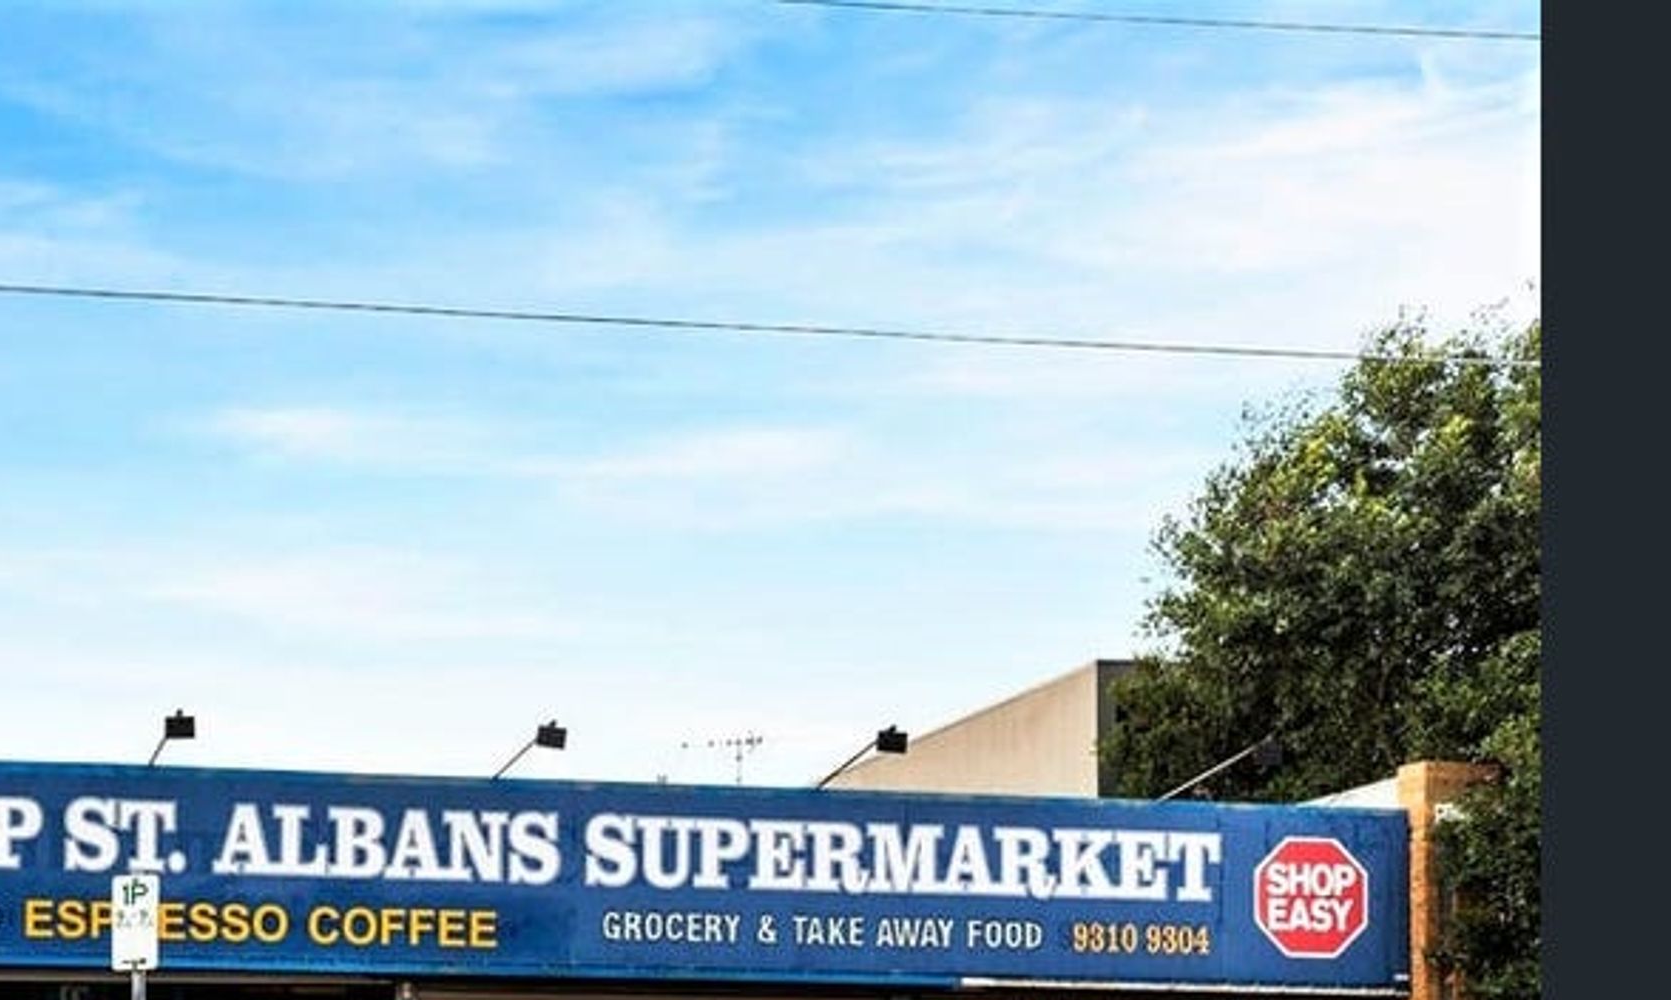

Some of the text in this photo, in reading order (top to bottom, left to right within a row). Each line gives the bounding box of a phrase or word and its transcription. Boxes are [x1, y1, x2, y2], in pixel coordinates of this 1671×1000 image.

[62, 796, 187, 874] ST.
[212, 803, 560, 887] ALBANS
[584, 813, 1223, 904] SUPERMARKET
[1266, 862, 1356, 896] SHOP
[24, 900, 289, 942] ESPESSO
[307, 905, 499, 948] COFFEE
[602, 911, 1043, 950] GROCERY & TAKE AWAY FOOD
[1267, 898, 1353, 932] EASY
[1072, 921, 1211, 955] 9310 9304
